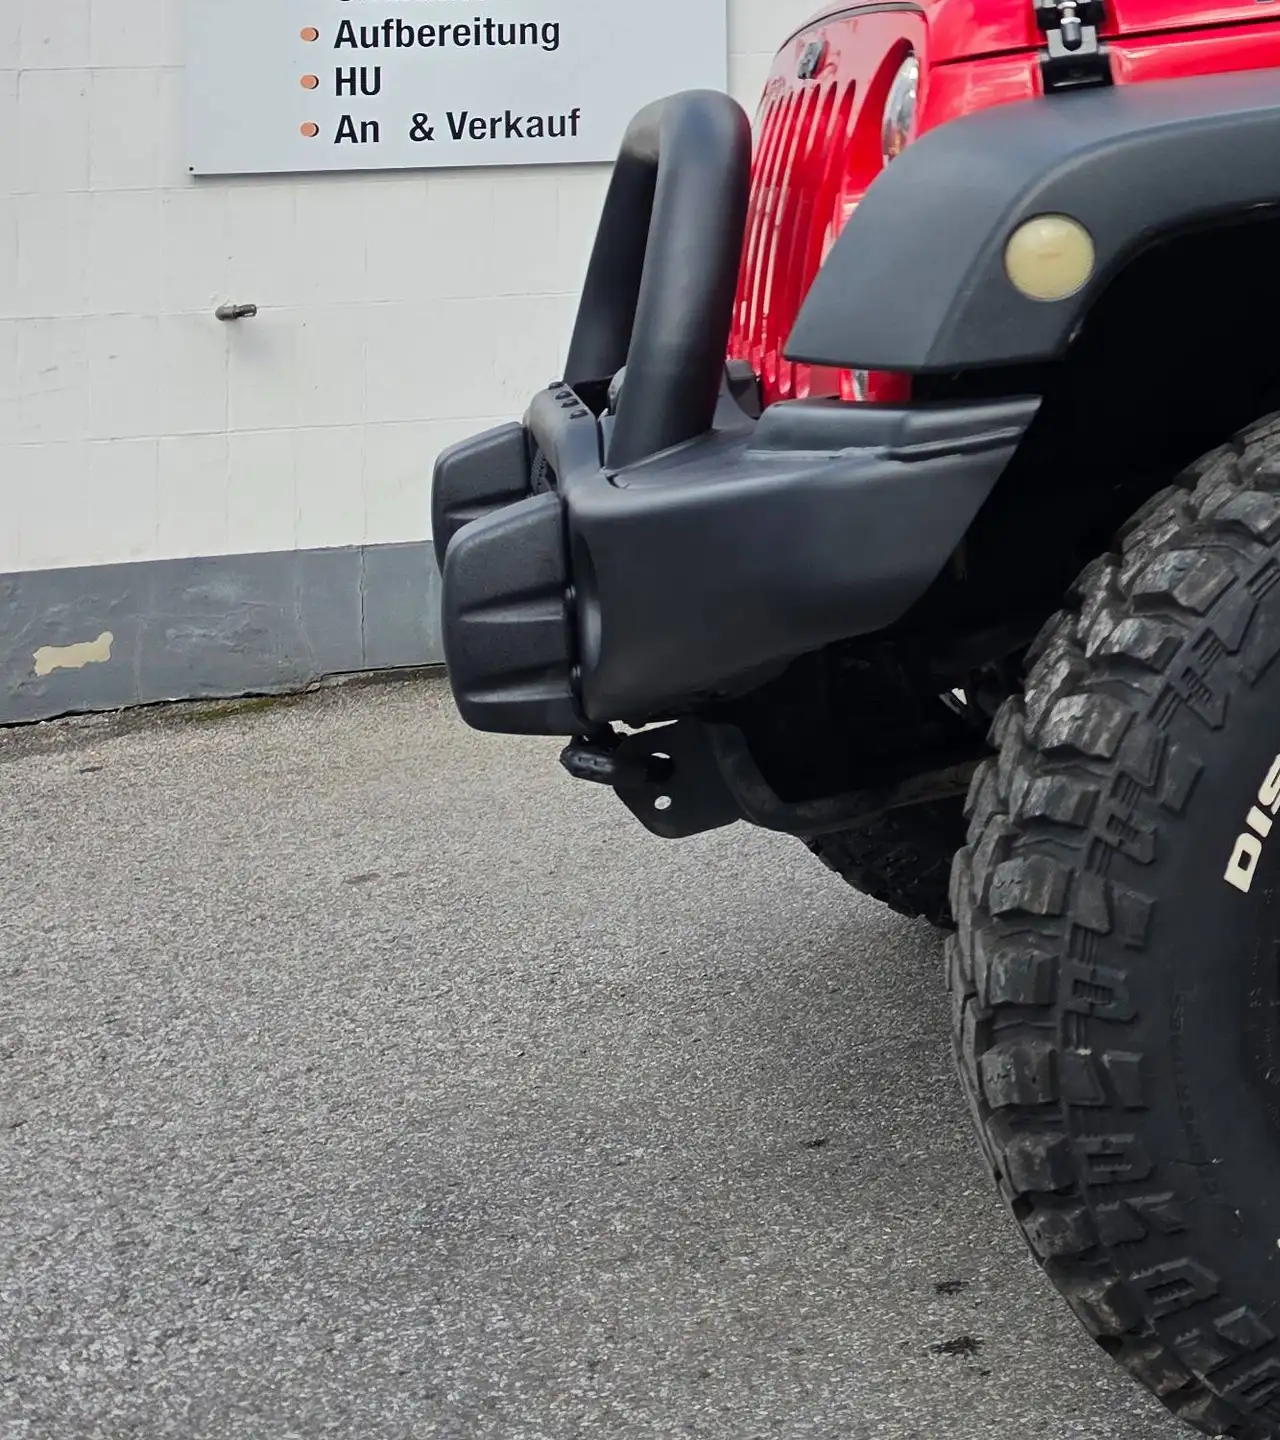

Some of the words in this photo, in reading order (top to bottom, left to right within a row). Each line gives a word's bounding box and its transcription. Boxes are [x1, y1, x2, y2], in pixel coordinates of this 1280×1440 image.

[334, 16, 560, 52] Aufbereitung
[335, 66, 381, 97] HU
[333, 114, 380, 144] An
[409, 112, 435, 142] &
[446, 107, 581, 140] Verkauf
